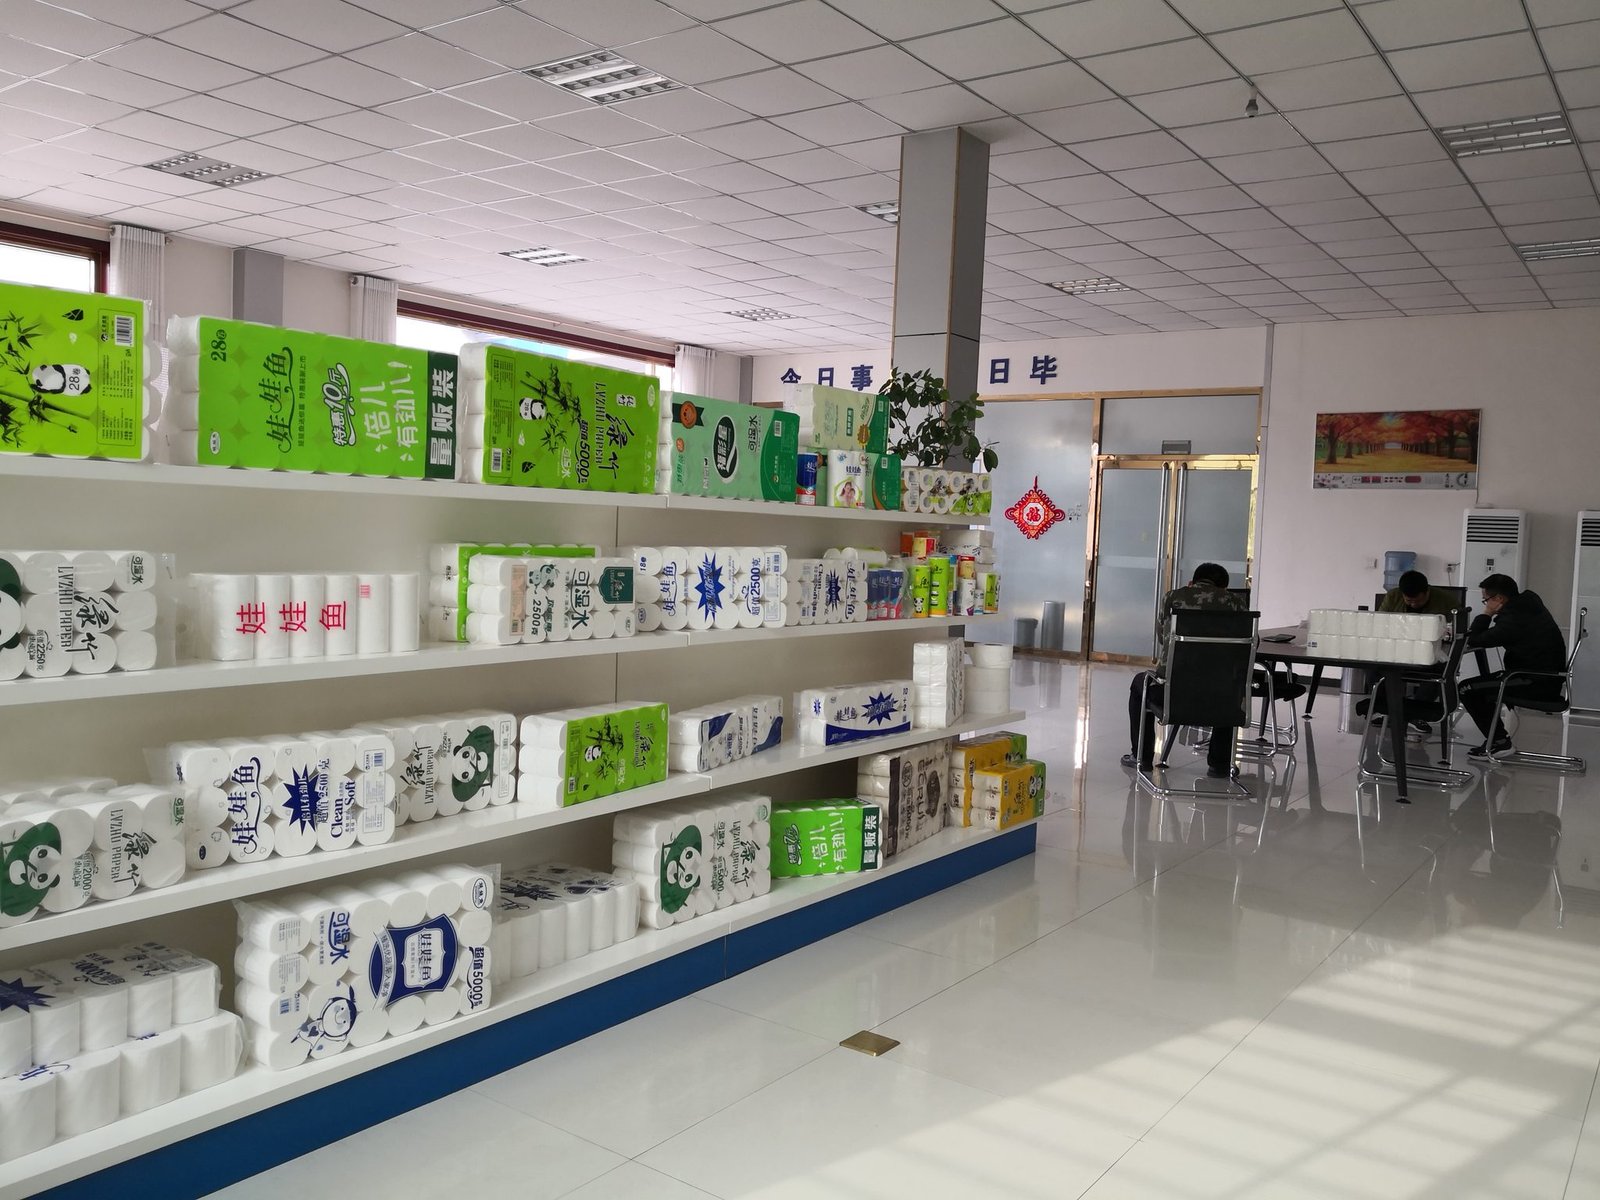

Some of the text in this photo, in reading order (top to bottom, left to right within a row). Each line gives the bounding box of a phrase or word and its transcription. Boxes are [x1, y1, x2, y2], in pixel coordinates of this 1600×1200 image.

[258, 346, 294, 454] 娃娃鱼
[780, 355, 1058, 392] 今日事 日毕
[322, 364, 351, 447] 特惠10斤
[360, 380, 392, 440] 倍儿
[387, 360, 419, 449] 有劲儿!
[429, 367, 454, 466] 量贩装
[57, 566, 74, 648] LVZHU PAPER
[571, 567, 590, 631] 可湿水
[660, 561, 678, 617] 娃娃鱼
[65, 594, 120, 660] 绿竹
[236, 600, 347, 635] 娃娃鱼
[318, 772, 329, 798] 2500
[400, 741, 432, 786] 绿竹
[424, 748, 434, 805] LVZHU PAPER
[227, 756, 262, 855] 娃娃鱼
[330, 797, 343, 839] Clean
[344, 779, 356, 806] Soft
[109, 808, 123, 880] LVZHU PAPER
[113, 831, 157, 887] 绿竹
[809, 825, 829, 860] 倍儿
[828, 811, 847, 862] 有劲儿!
[863, 814, 877, 864] 量贩装
[328, 911, 350, 965] 可湿水
[420, 933, 433, 981] 娃娃鱼
